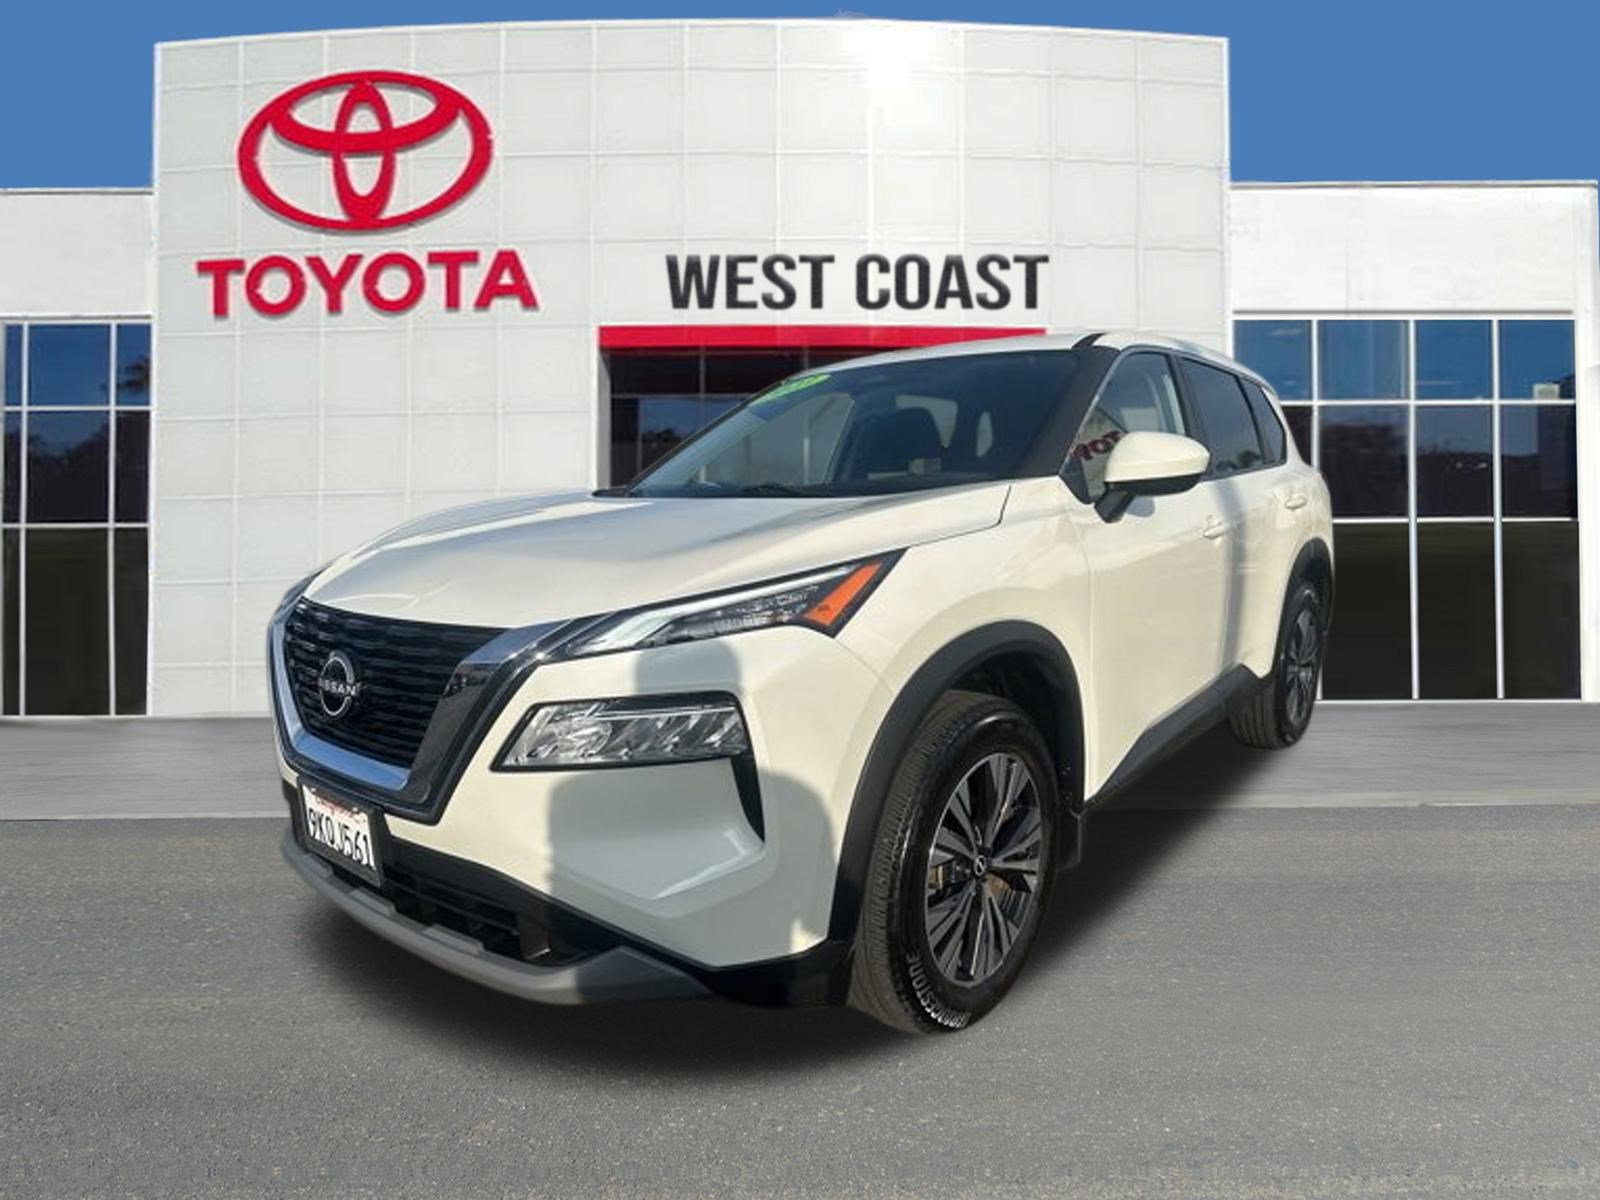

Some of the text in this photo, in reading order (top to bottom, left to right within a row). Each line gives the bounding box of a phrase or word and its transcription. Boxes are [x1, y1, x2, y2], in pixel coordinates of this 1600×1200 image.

[196, 250, 538, 318] TOYOTA
[666, 253, 1050, 310] WEST COAST
